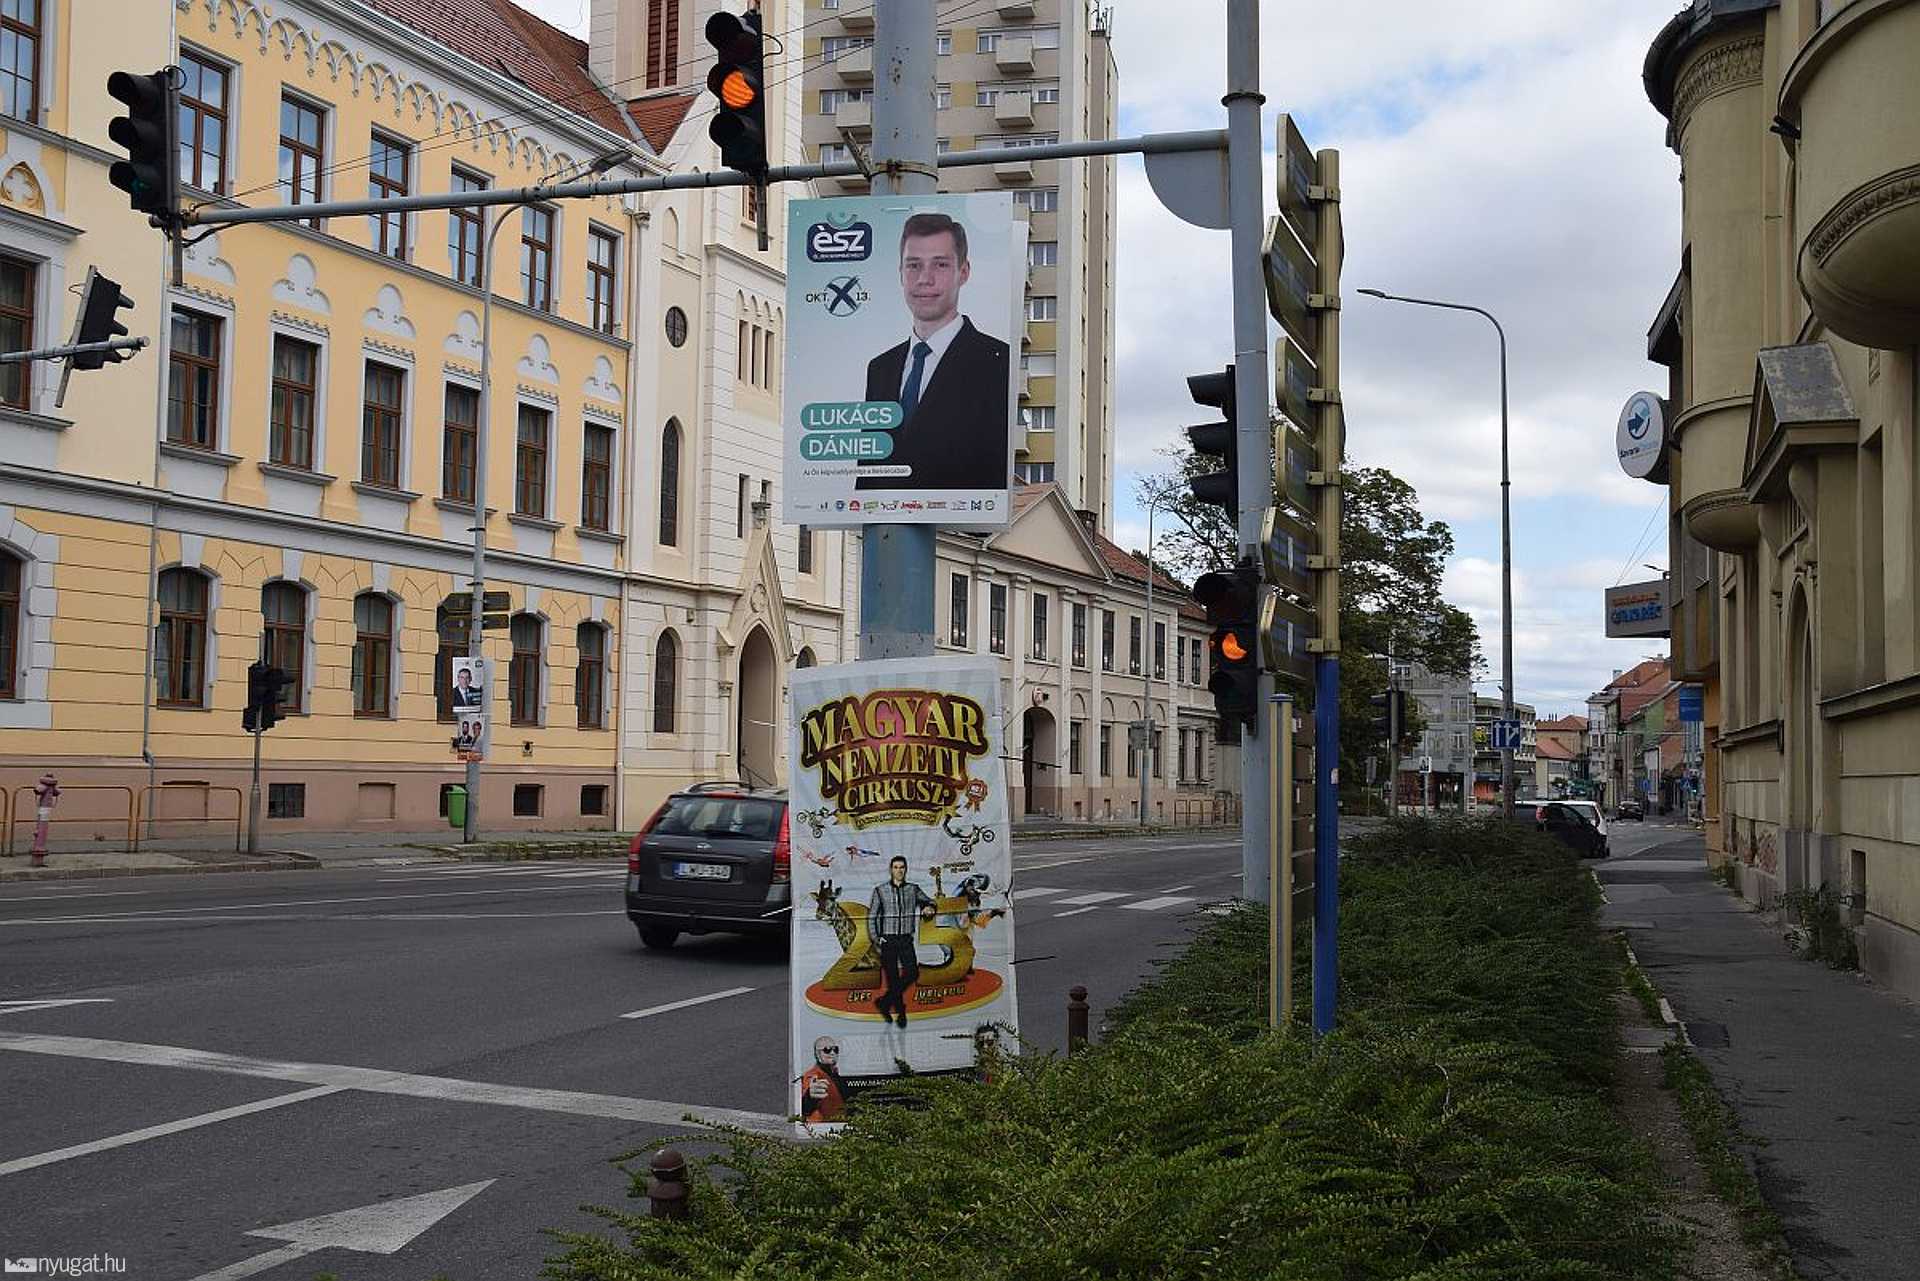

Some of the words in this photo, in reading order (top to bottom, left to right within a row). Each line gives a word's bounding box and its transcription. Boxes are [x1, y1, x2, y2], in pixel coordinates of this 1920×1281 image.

[806, 292, 829, 303] OKT.
[809, 403, 892, 425] LUKÁCS
[809, 435, 884, 456] DÁNIEL
[805, 698, 983, 758] MAGYAR
[824, 743, 962, 792] NEMZETI
[842, 779, 944, 811] CIRKUSZ
